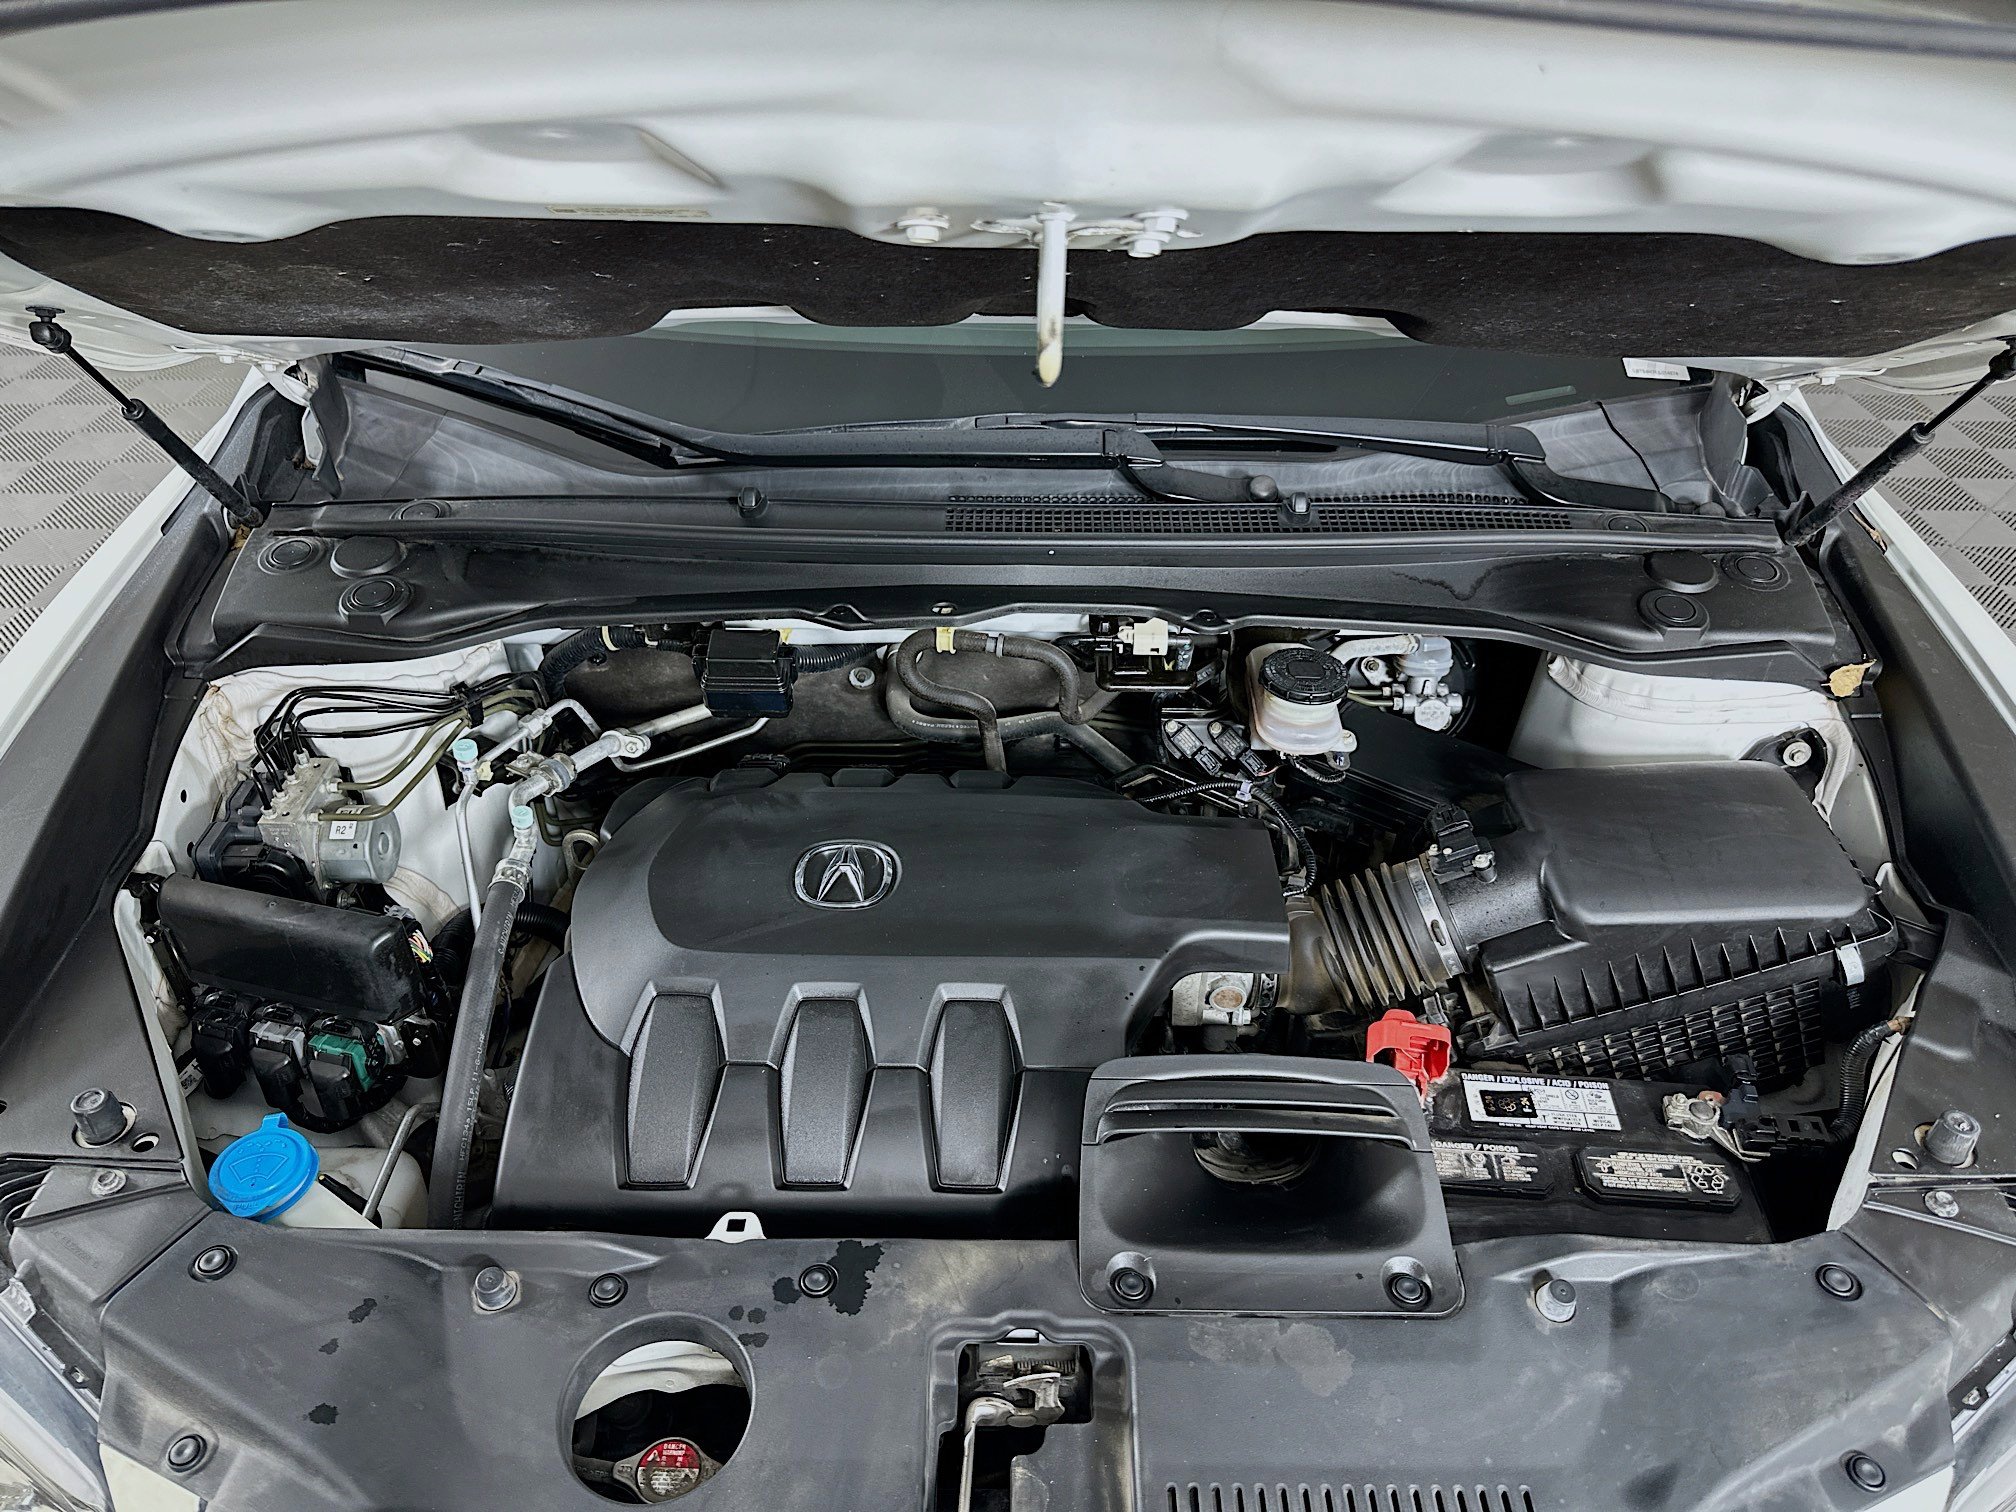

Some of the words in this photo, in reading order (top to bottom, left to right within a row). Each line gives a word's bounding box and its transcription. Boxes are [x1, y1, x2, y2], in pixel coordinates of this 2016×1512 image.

[1461, 1073, 1495, 1083] DANGER
[1501, 1076, 1546, 1086] EXPLOSIVE
[1551, 1079, 1572, 1088] ACID
[1578, 1081, 1610, 1090] POISON
[1435, 1141, 1474, 1150] DANGER
[1483, 1144, 1519, 1153] POISON
